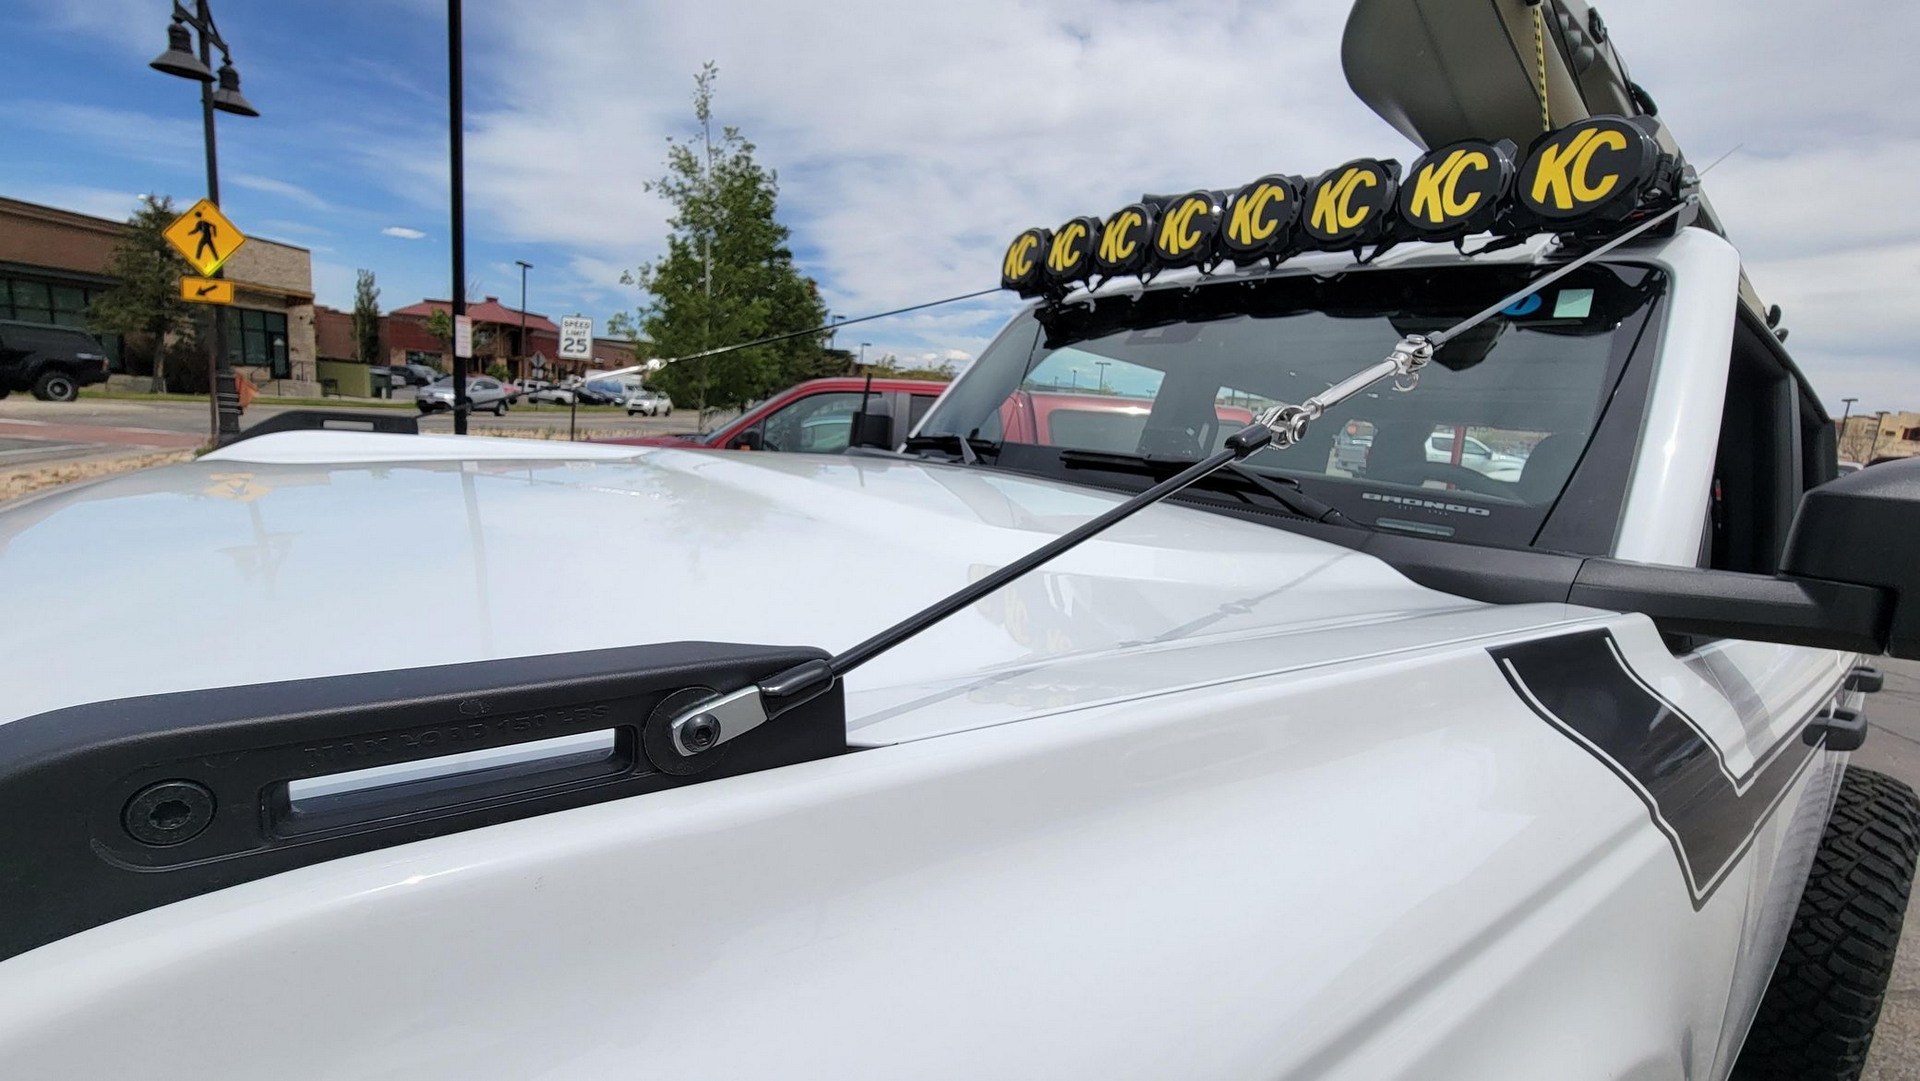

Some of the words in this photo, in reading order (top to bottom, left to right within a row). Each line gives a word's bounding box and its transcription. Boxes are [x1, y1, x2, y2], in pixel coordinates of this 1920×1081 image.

[1410, 150, 1488, 223] KC
[1531, 128, 1627, 209] KC
[1229, 184, 1285, 245] KC
[1311, 168, 1376, 234] KC
[1049, 224, 1085, 270] KC
[1100, 213, 1141, 262] KC
[1159, 198, 1207, 254] KC
[1004, 235, 1038, 280] KC
[563, 337, 587, 353] 25
[564, 320, 590, 328] SPEED
[1362, 492, 1490, 516] BRONCO
